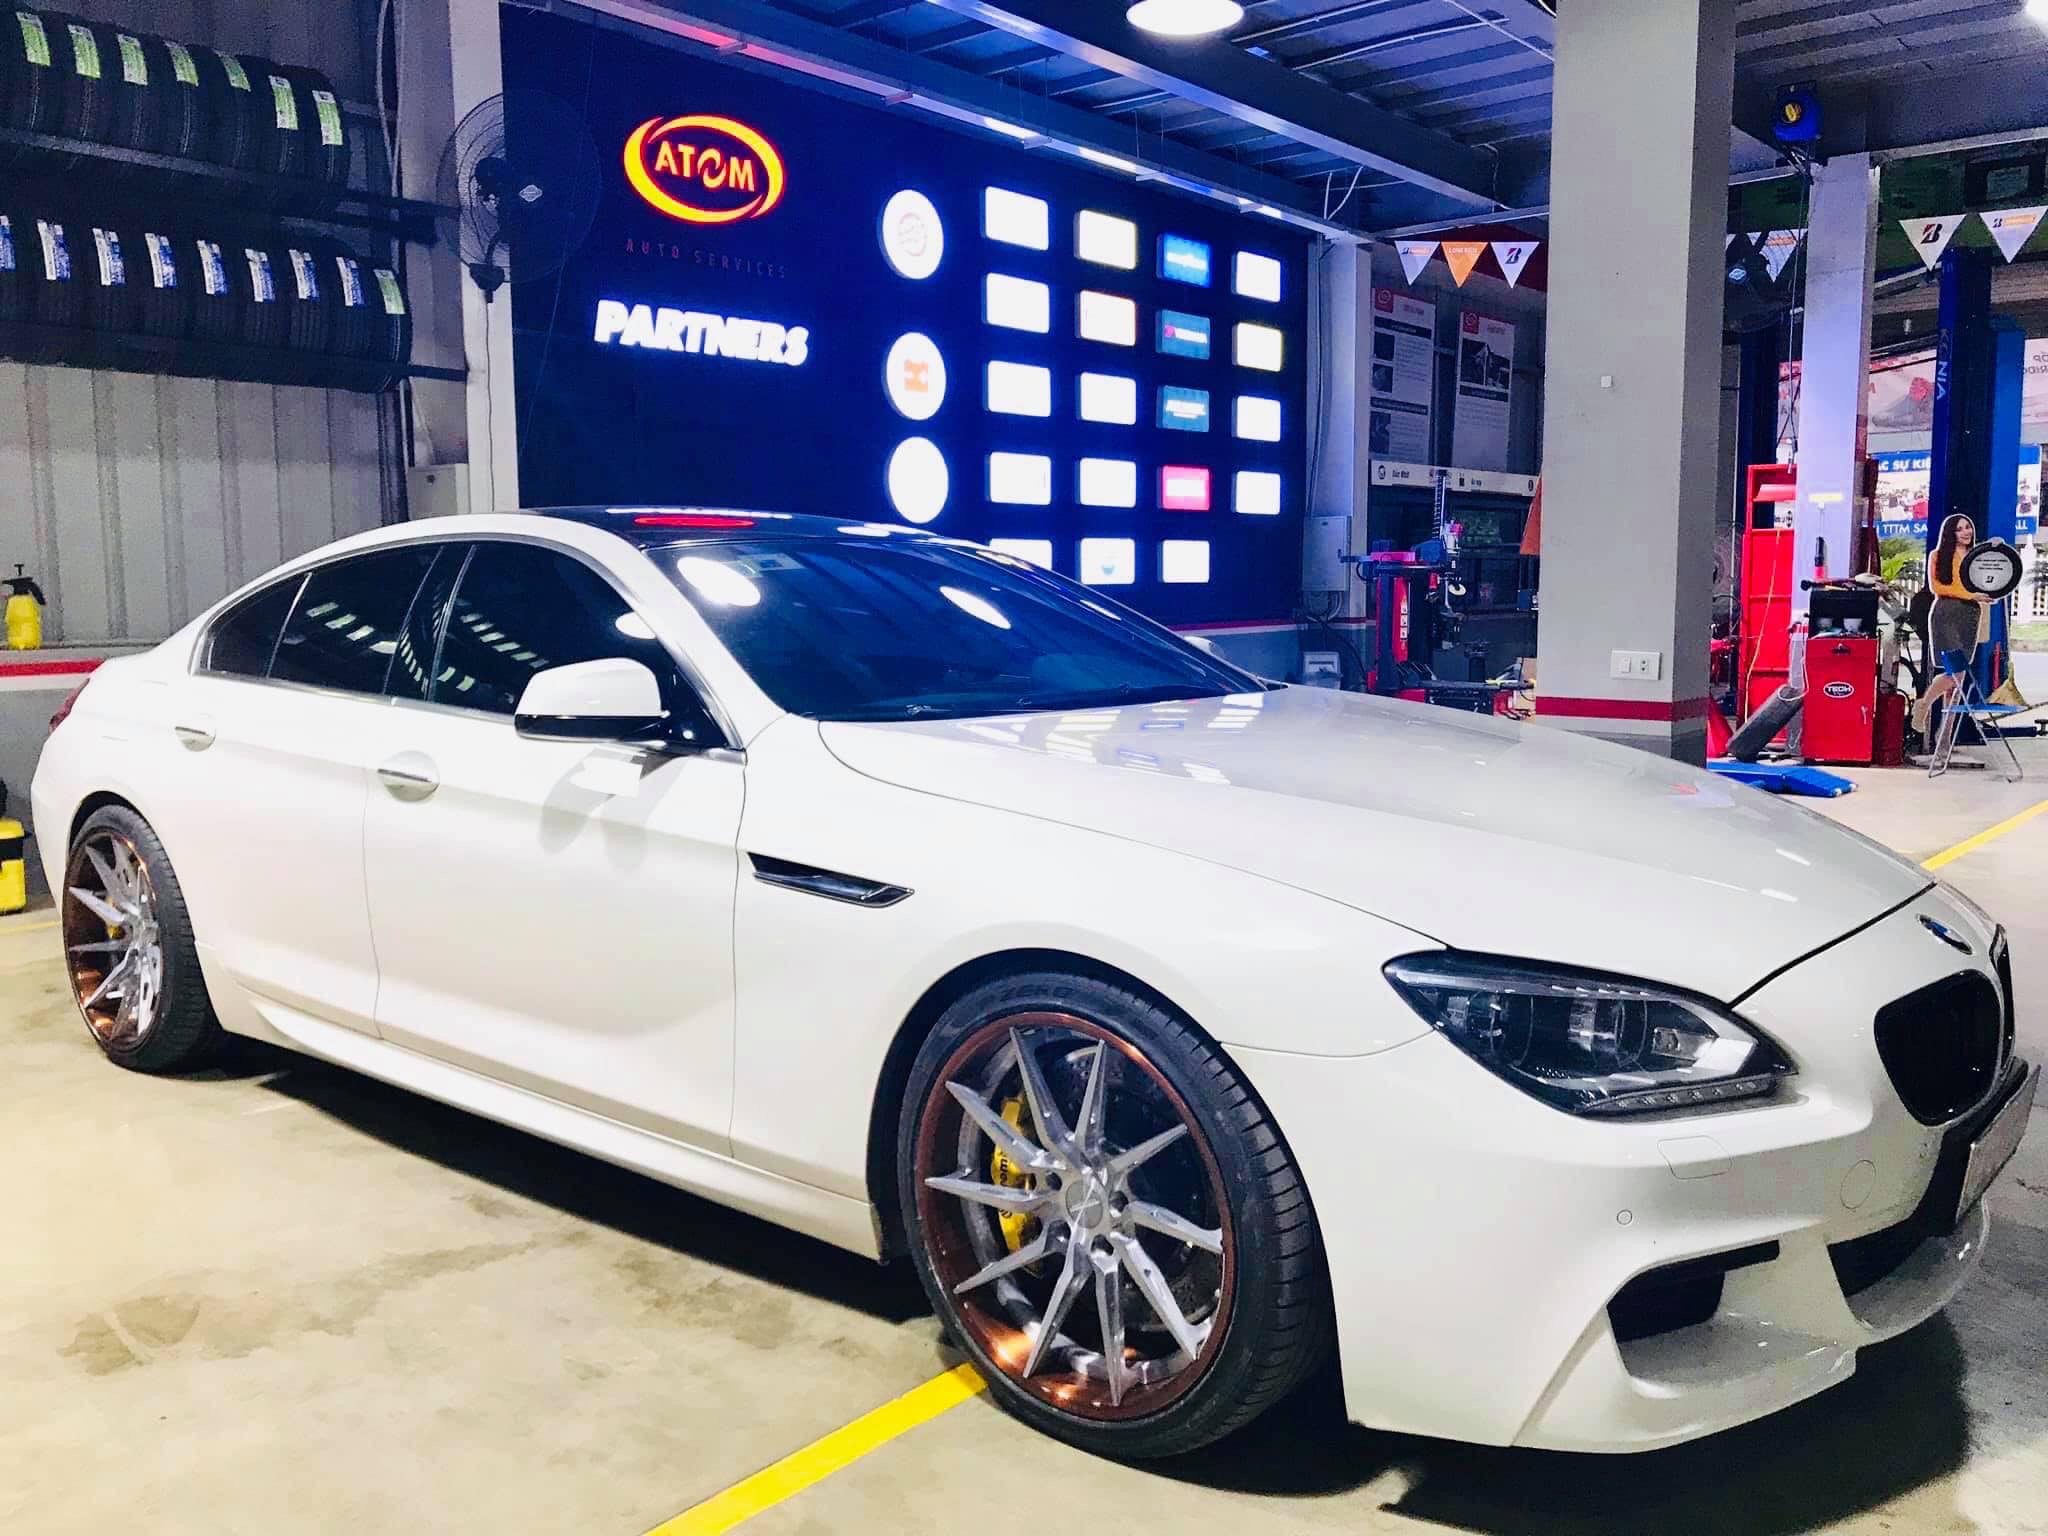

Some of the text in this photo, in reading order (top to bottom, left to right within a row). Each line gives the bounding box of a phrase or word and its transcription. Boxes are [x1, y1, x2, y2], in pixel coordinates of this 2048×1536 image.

[654, 139, 756, 192] ATOM
[625, 238, 785, 279] AUTO SERVICES
[593, 298, 809, 367] PARTNERS
[1883, 523, 1910, 535] TTTM
